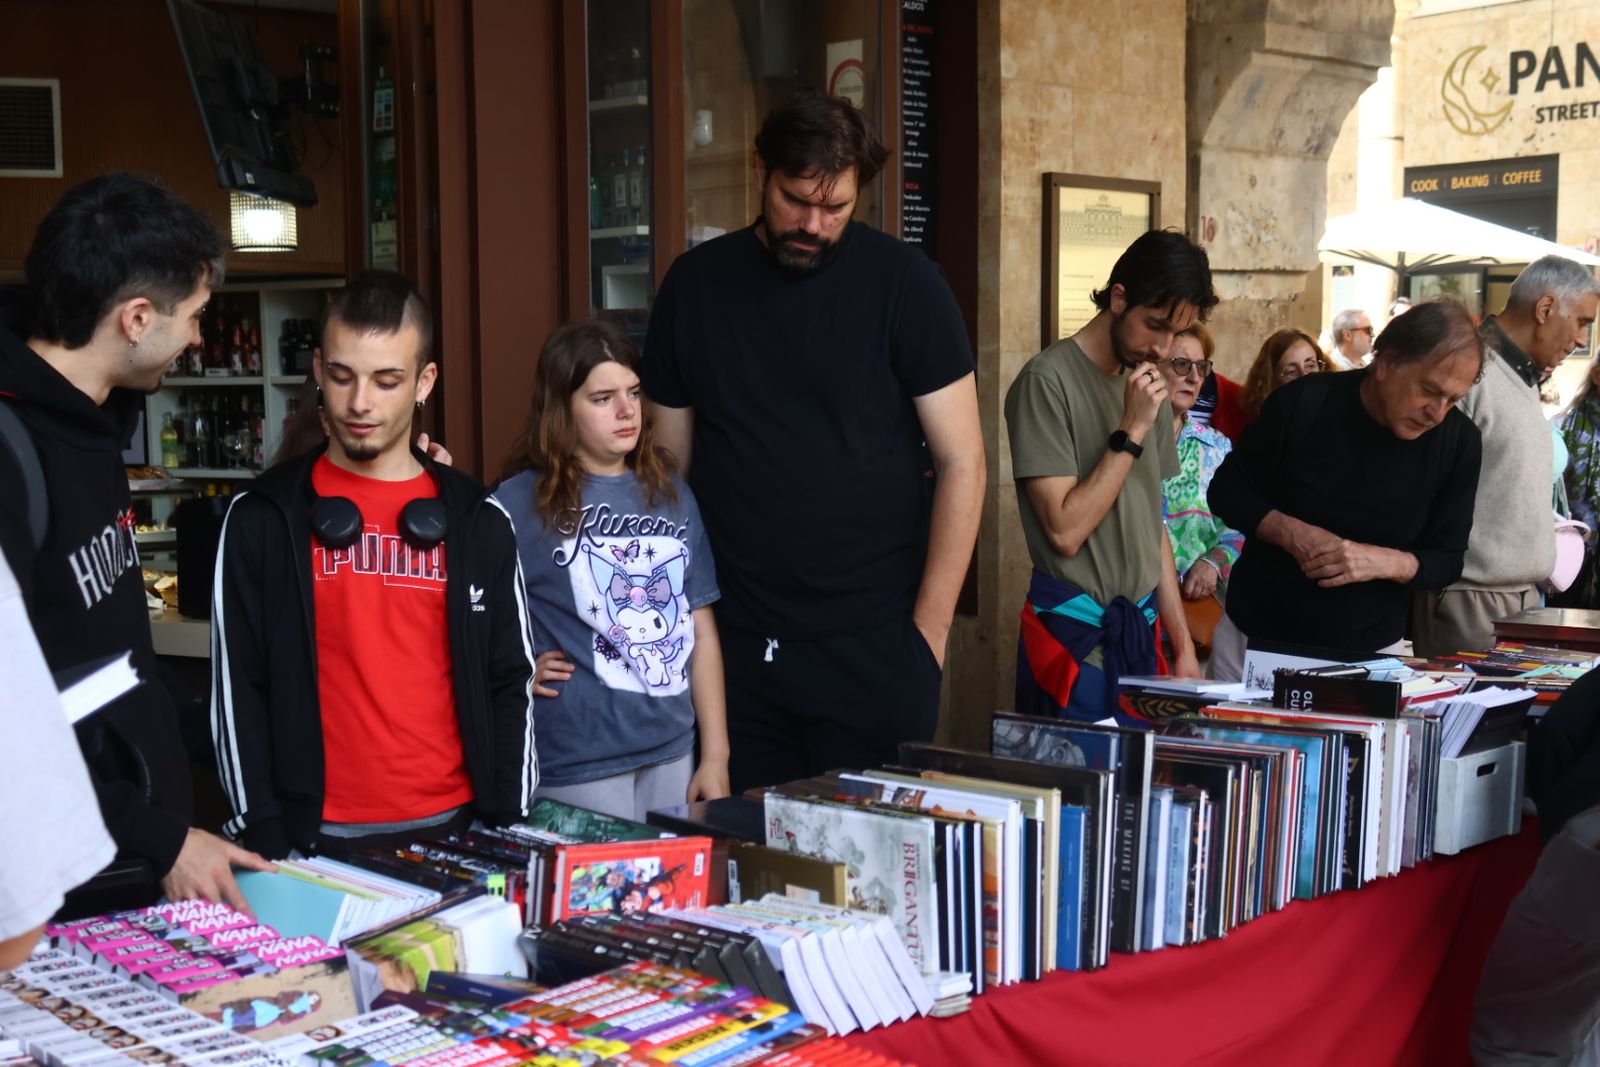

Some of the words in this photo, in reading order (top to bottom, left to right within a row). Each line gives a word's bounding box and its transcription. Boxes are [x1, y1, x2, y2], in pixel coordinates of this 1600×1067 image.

[1508, 41, 1600, 95] PAN
[1535, 101, 1600, 124] STREET
[1411, 178, 1439, 193] COOK
[1451, 174, 1489, 189] BAKING
[1502, 170, 1542, 185] COFFEE
[1124, 802, 1135, 822] THE
[1121, 829, 1134, 872] MAKING
[1120, 876, 1130, 893] OF
[147, 899, 205, 916] NANA
[171, 903, 230, 924] NANA
[190, 911, 250, 932] NANA
[212, 925, 274, 946] NANA
[258, 935, 321, 958] NANA
[276, 946, 338, 967] NANA
